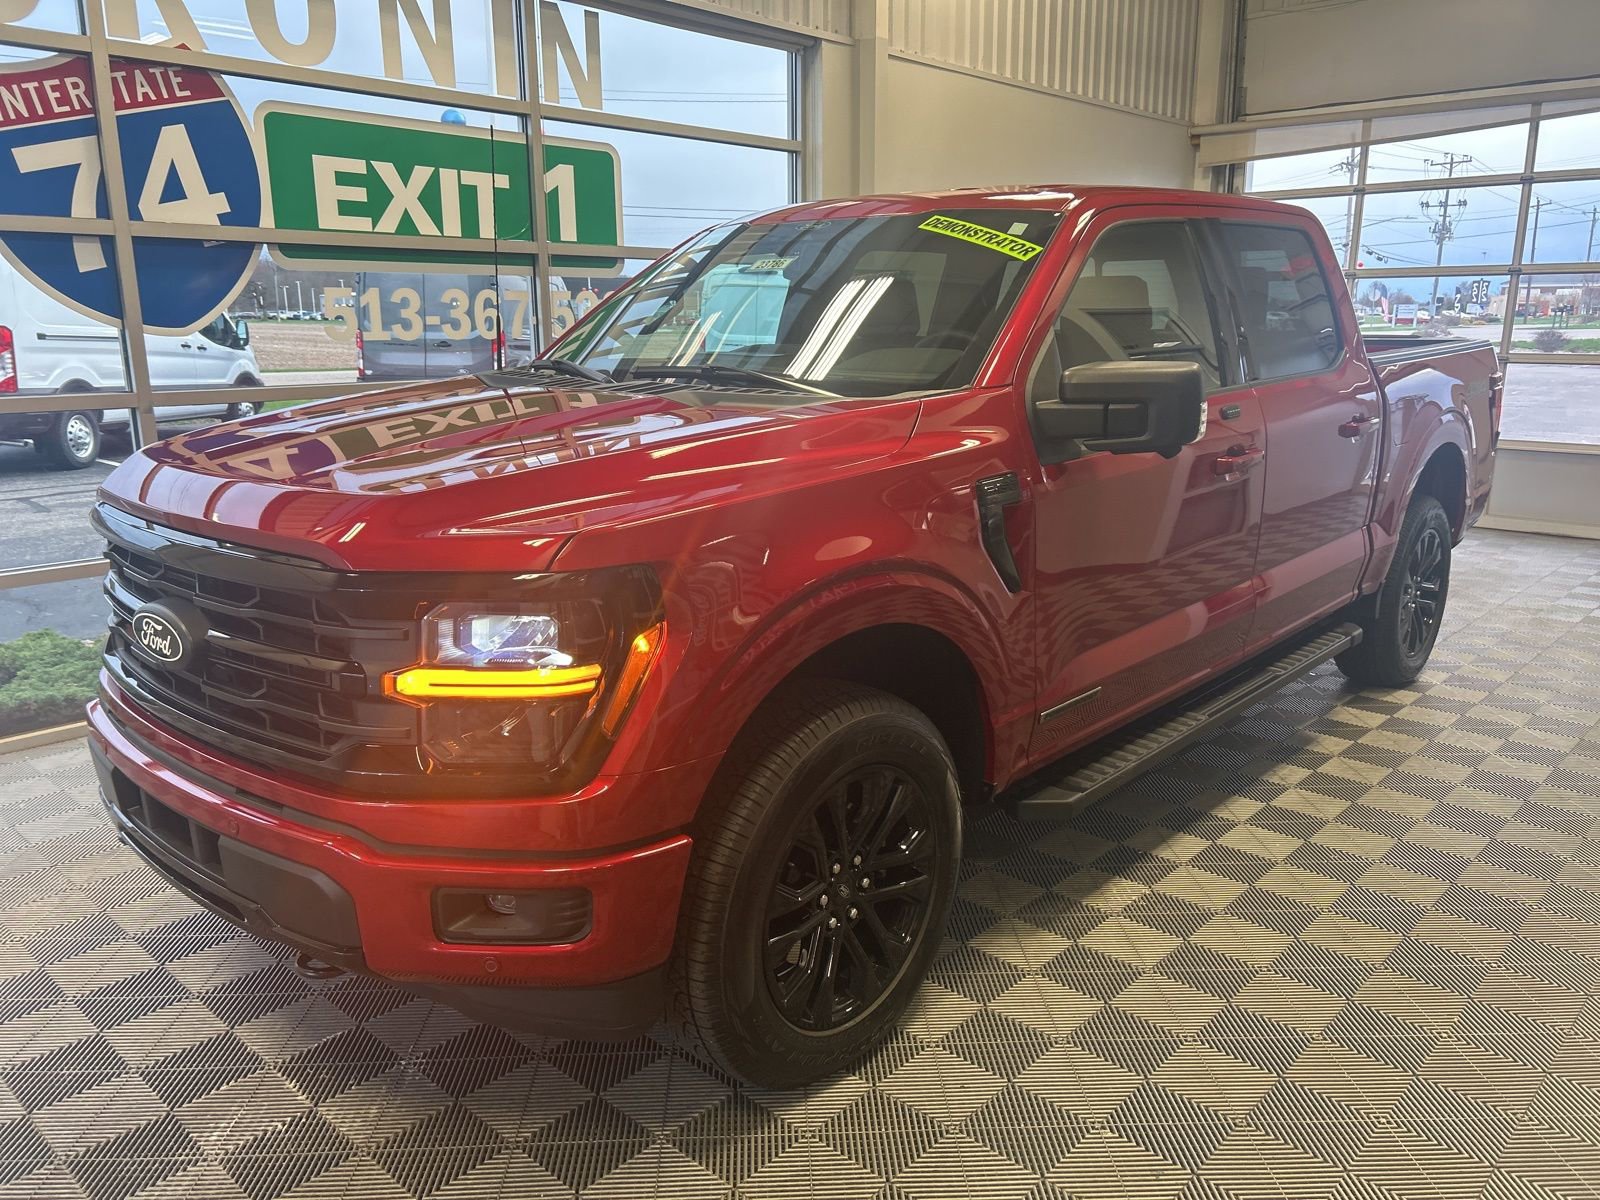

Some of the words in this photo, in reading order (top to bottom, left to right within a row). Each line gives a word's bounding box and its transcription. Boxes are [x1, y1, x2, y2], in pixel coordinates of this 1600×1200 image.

[0, 66, 192, 122] NTERTATE
[11, 123, 231, 273] 74
[312, 154, 510, 239] EXIT
[543, 164, 578, 242] 1
[924, 217, 1037, 257] DEMONSTRATOR
[141, 618, 172, 655] Ford
